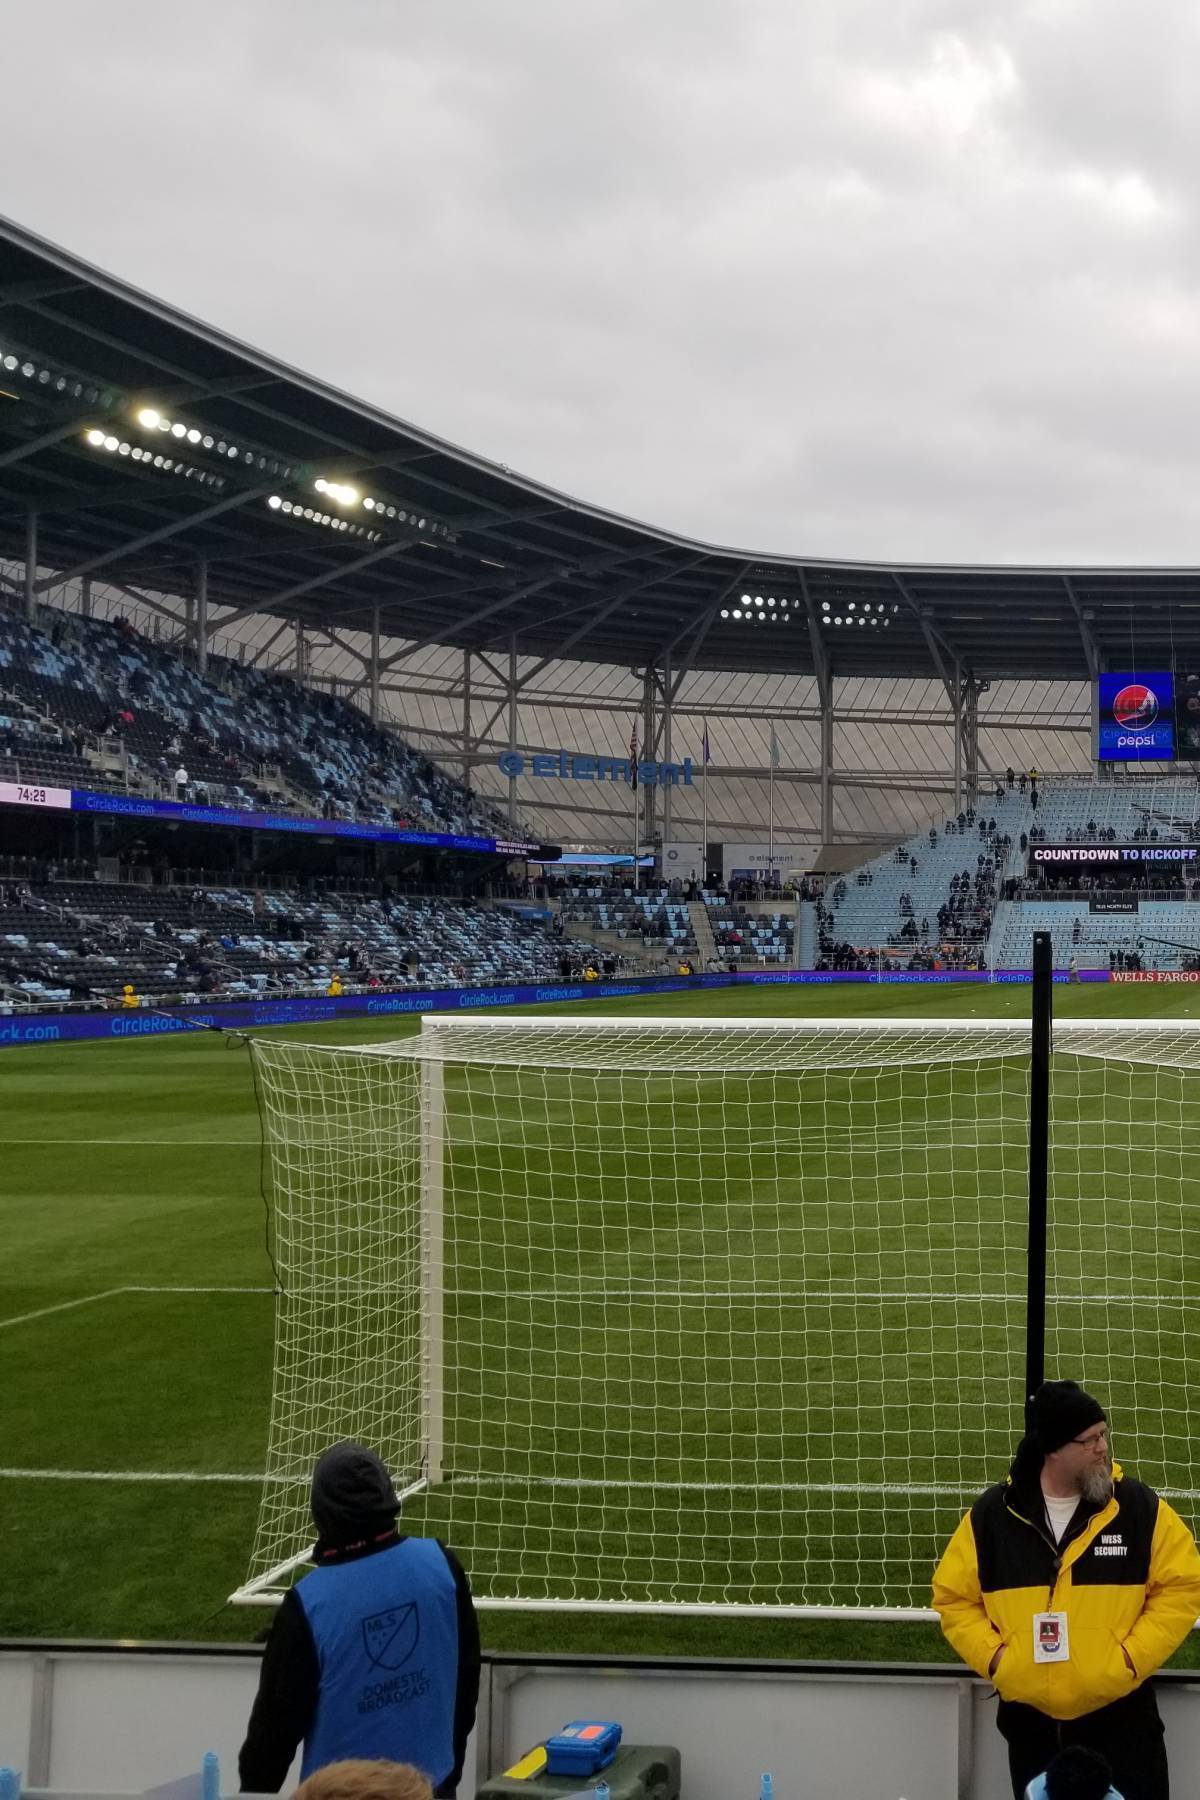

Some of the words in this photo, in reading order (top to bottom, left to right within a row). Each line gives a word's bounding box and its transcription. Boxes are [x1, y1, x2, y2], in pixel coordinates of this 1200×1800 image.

[1117, 734, 1155, 748] pepsi
[532, 748, 694, 786] element
[17, 787, 46, 802] 74:29
[86, 796, 154, 815] CircleRock.com
[1034, 849, 1119, 861] COUNTDOWN
[1122, 849, 1139, 861] TO
[1141, 849, 1197, 860] KICKOFF
[752, 975, 833, 984] CircleRock.com
[868, 974, 950, 984] CircleRock.com
[1111, 971, 1154, 982] WELLS
[1157, 971, 1199, 982] FARGO
[459, 992, 516, 1007] CircleRock.com
[535, 988, 584, 1001] CircleRock.com
[1101, 1534, 1122, 1545] WESS
[1094, 1546, 1128, 1556] SECURITY
[367, 1612, 397, 1632] MLS
[362, 1668, 428, 1697] DOMESTIC
[357, 1679, 433, 1714] BROADCAST
